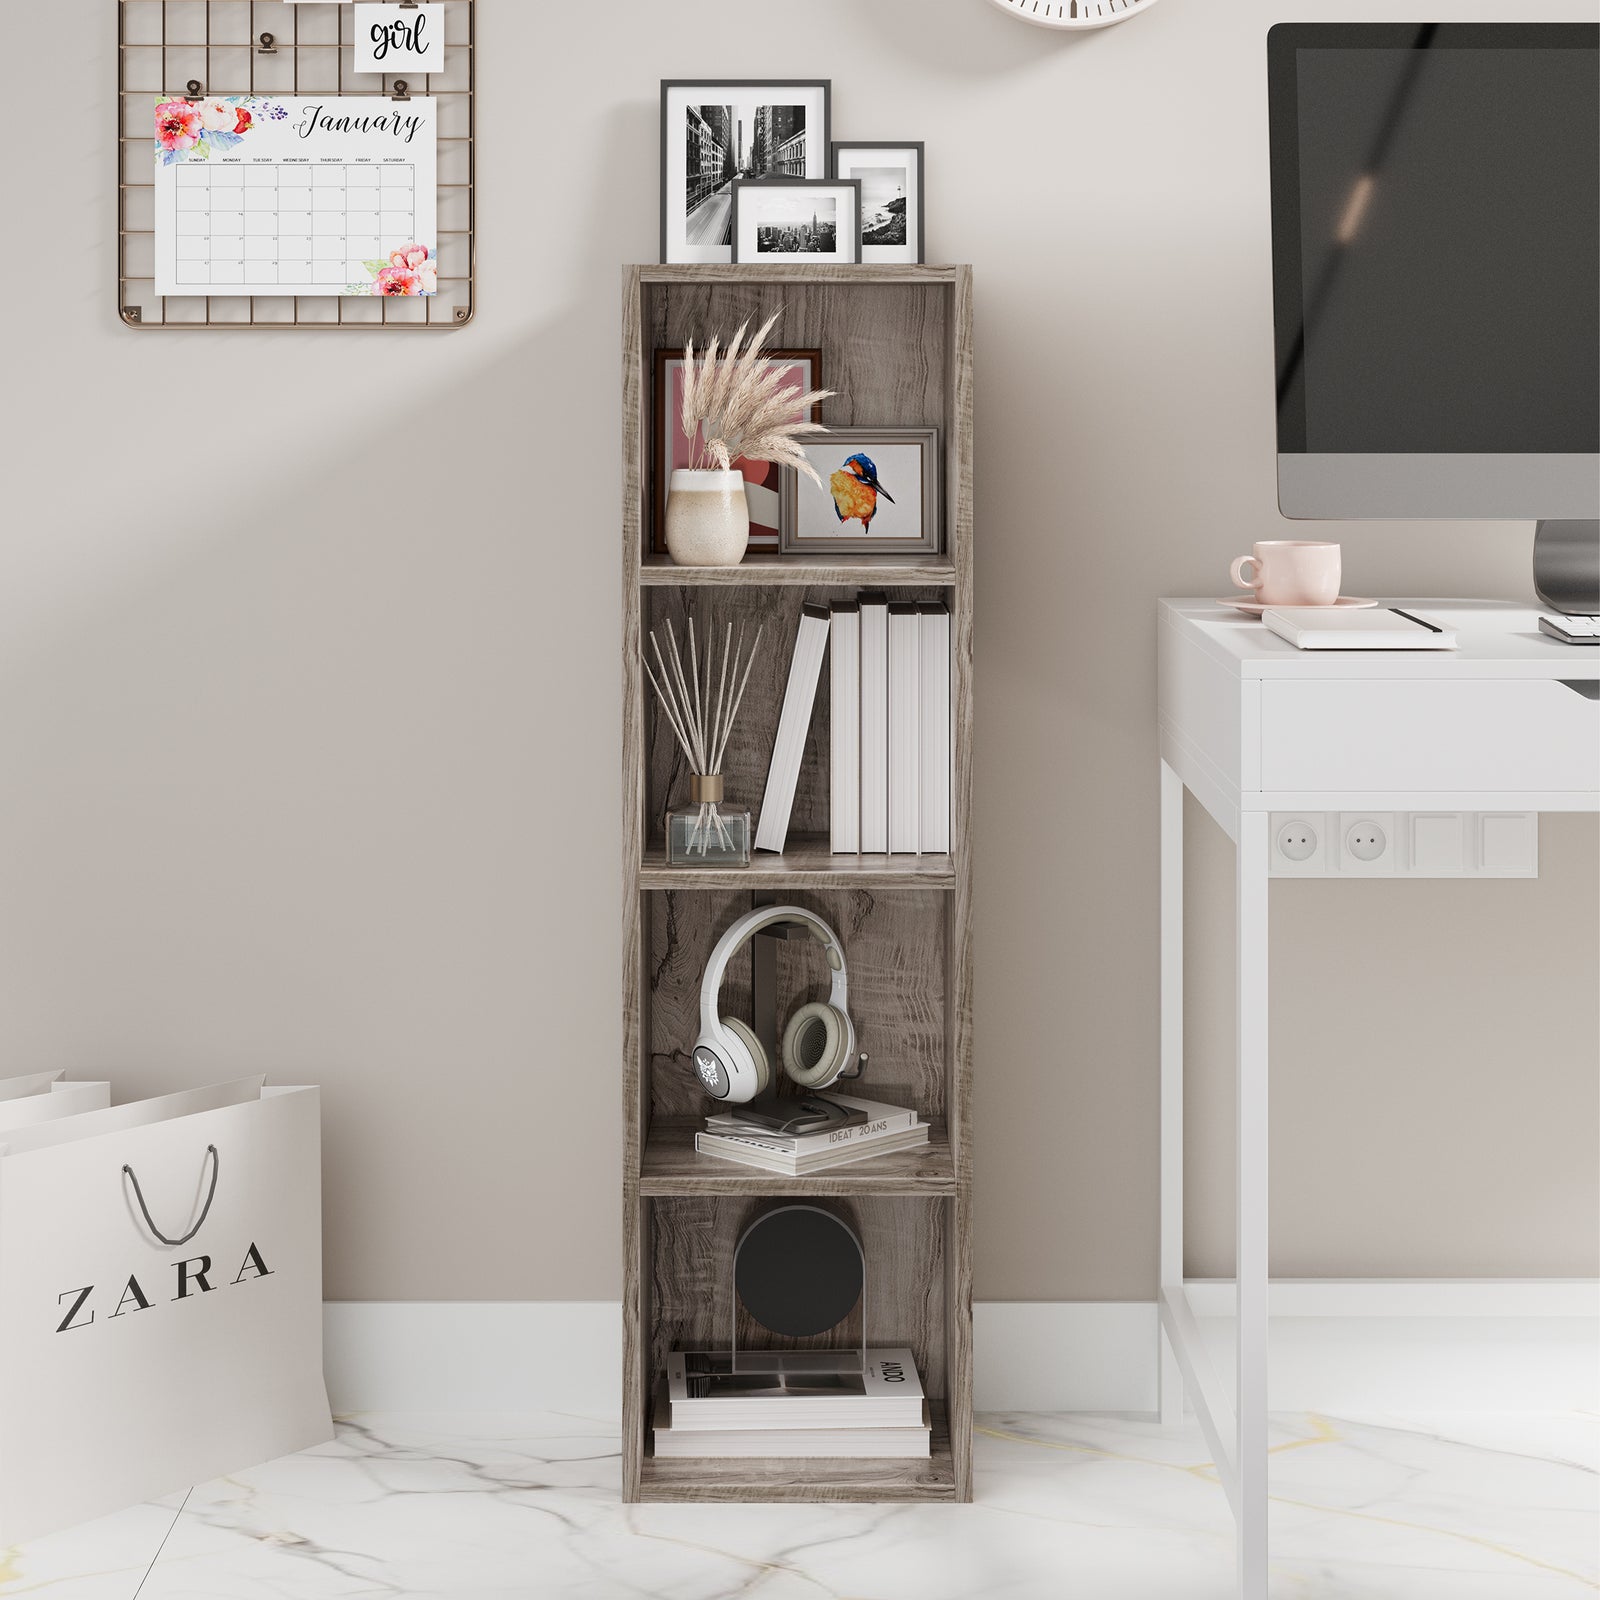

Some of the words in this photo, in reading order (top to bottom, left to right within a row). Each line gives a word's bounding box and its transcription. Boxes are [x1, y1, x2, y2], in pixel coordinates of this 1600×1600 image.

[370, 13, 430, 60] girl
[292, 105, 426, 144] January
[829, 1128, 854, 1143] IDEAT
[55, 1241, 276, 1333] ZARA
[879, 1361, 906, 1383] ANDO
